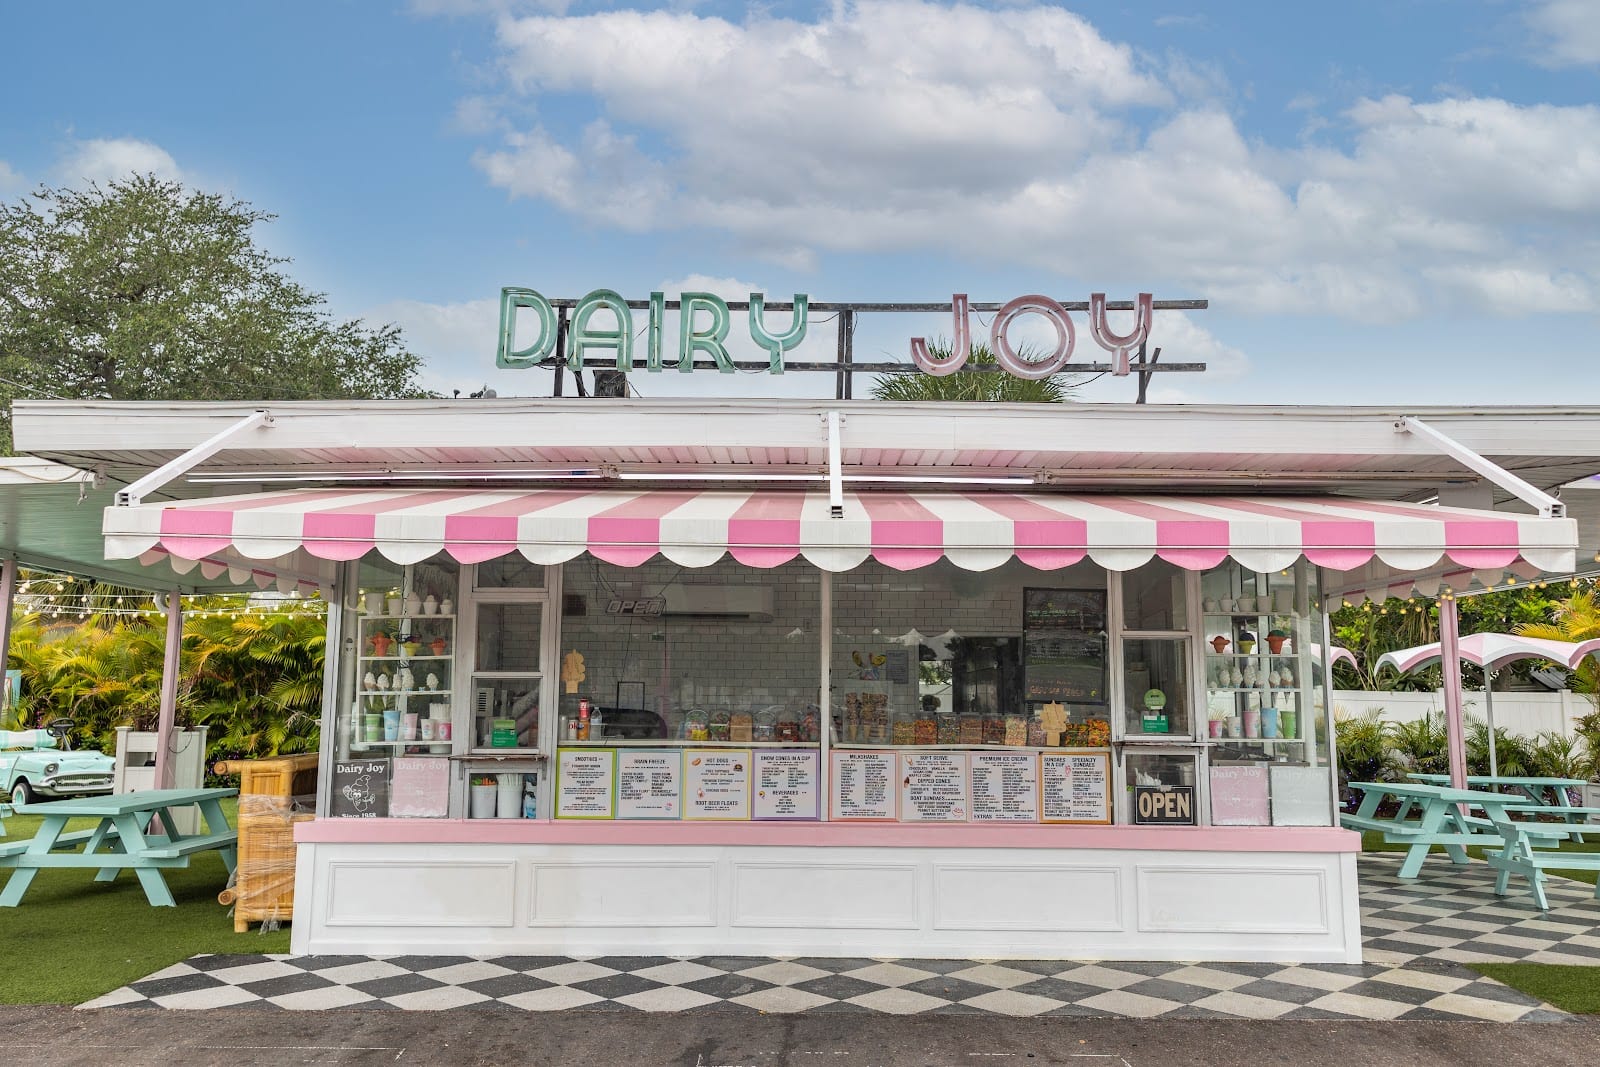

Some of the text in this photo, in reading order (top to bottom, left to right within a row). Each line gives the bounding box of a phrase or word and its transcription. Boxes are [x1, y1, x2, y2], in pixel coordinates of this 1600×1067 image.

[496, 286, 1153, 380] DAIRY JOY
[607, 600, 661, 615] OPEN
[336, 763, 385, 774] Dairy Joy
[397, 761, 425, 771] Dairy
[1138, 792, 1190, 818] OPEN
